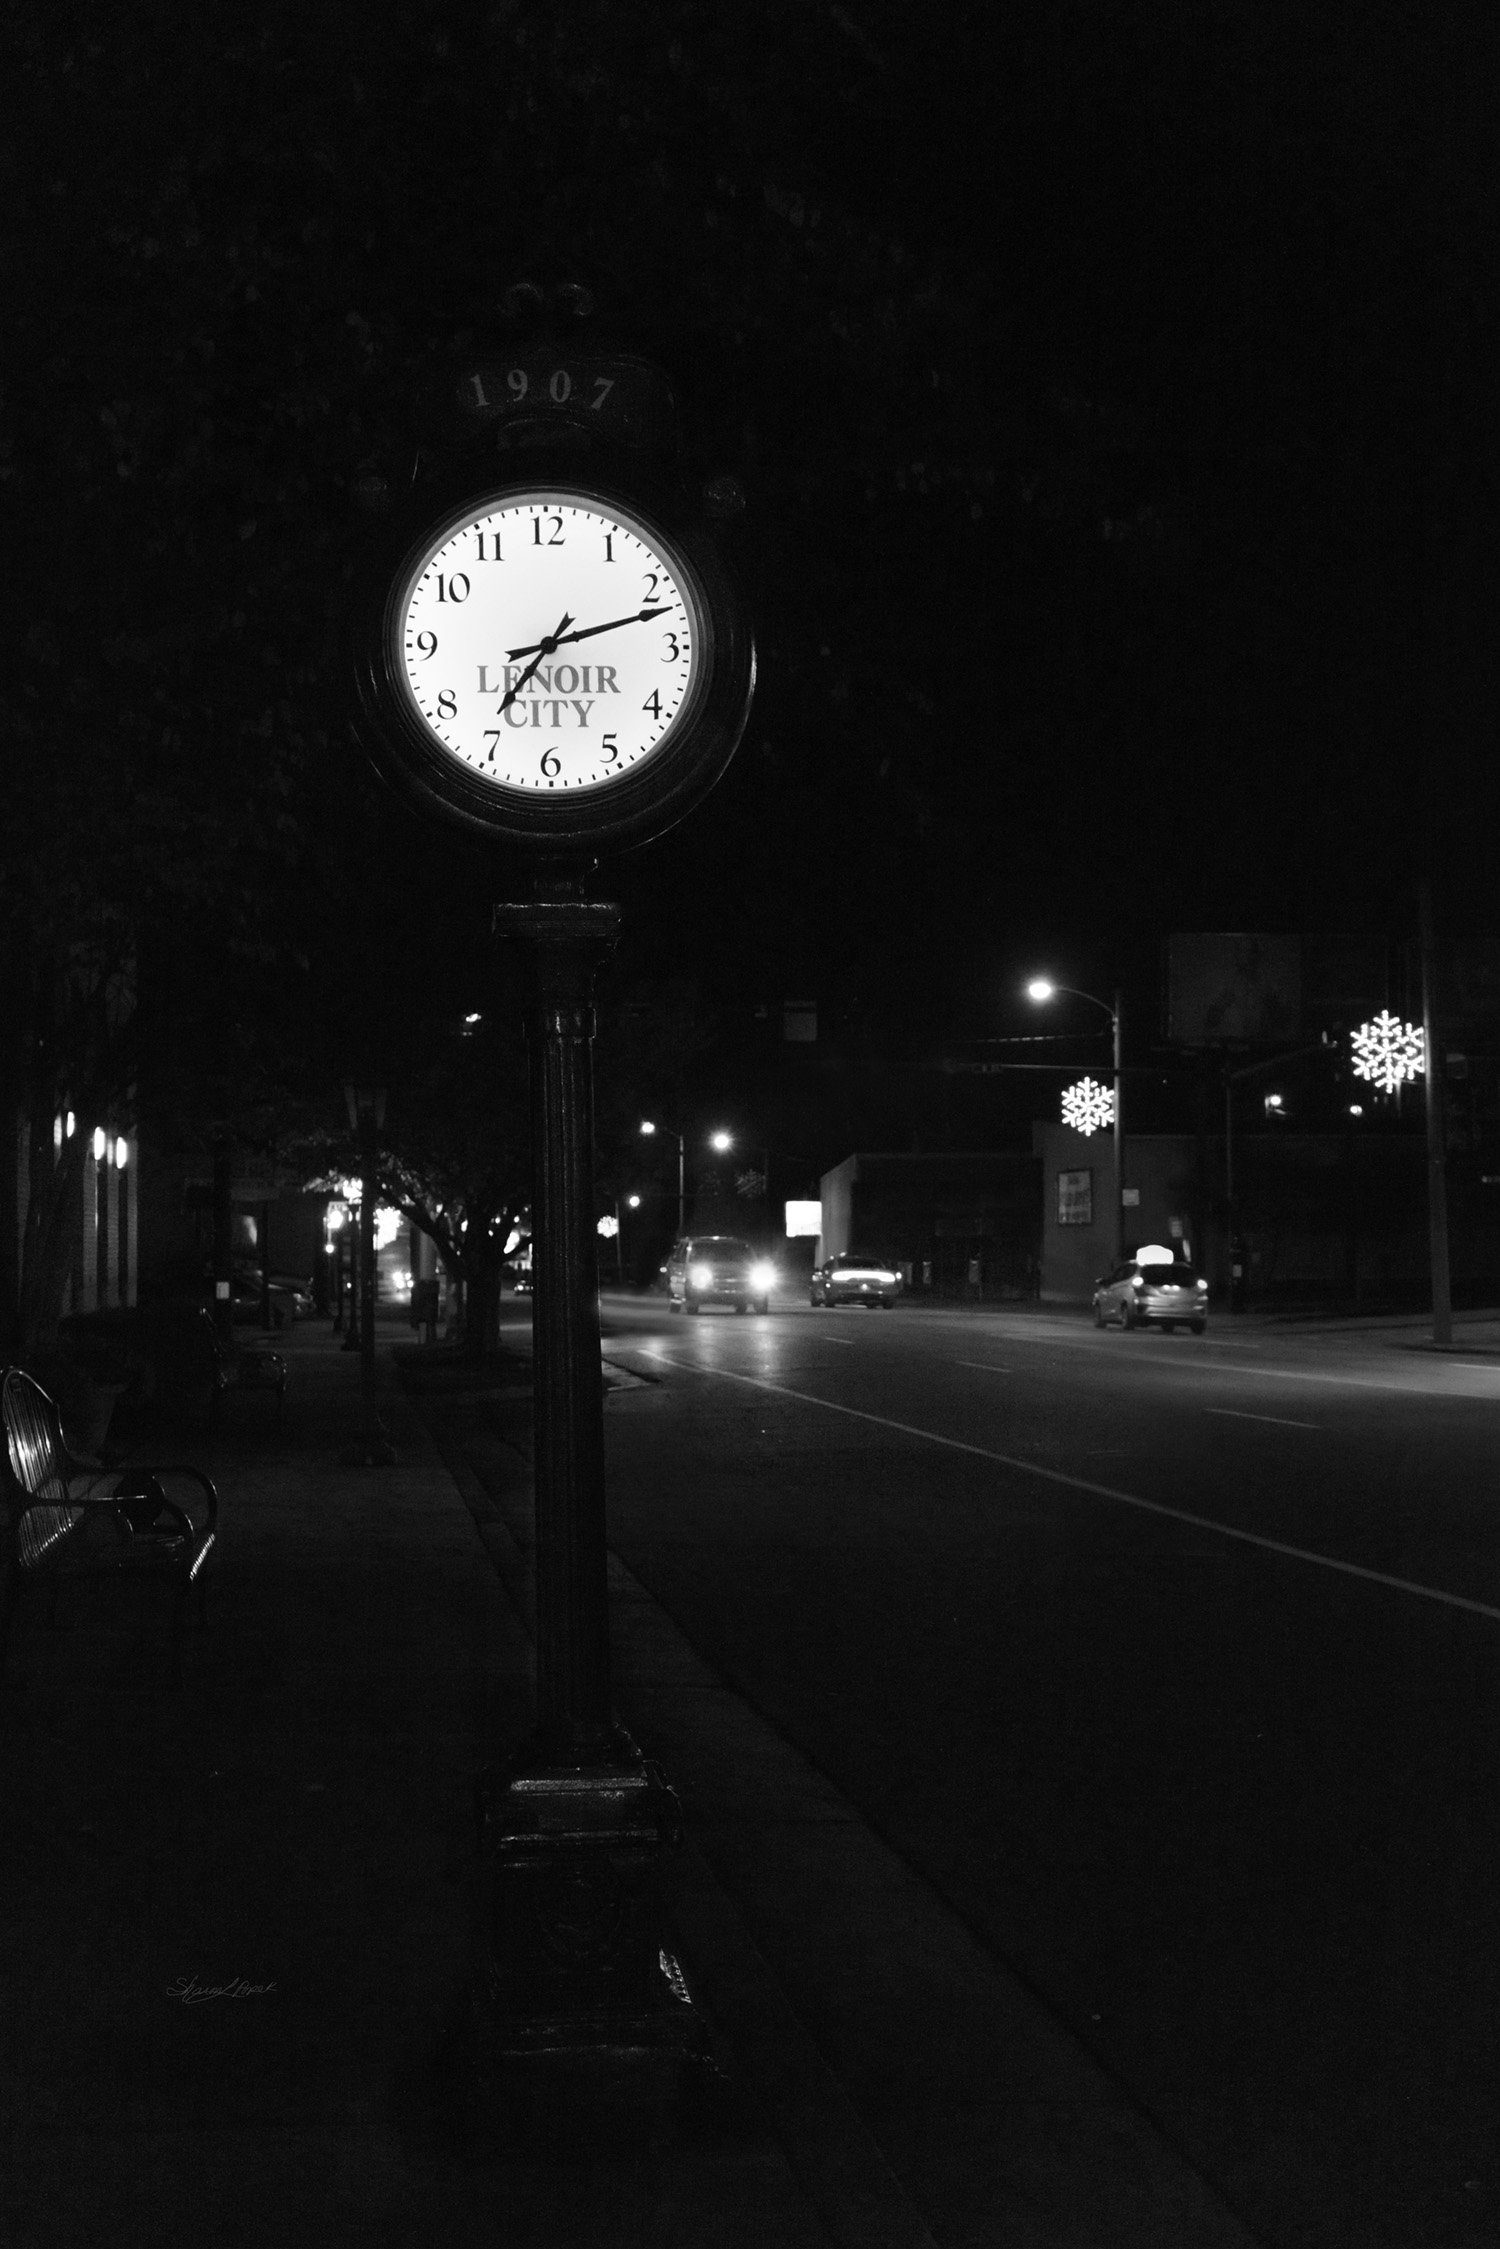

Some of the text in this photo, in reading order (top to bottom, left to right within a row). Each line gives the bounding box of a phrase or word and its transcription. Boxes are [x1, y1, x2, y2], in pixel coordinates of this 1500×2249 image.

[469, 369, 616, 410] 1907
[531, 515, 566, 546] 12
[476, 532, 505, 562] 11
[603, 532, 617, 563] 1
[435, 573, 471, 603] 10
[642, 573, 661, 603] 2
[416, 631, 438, 661] 9
[660, 632, 680, 663] 3
[477, 664, 621, 694] LENOIR
[437, 689, 458, 720] 8
[502, 699, 596, 728] CITY
[642, 687, 664, 720] 4
[483, 730, 501, 762] 7
[599, 733, 620, 763] 5
[540, 747, 562, 778] 6
